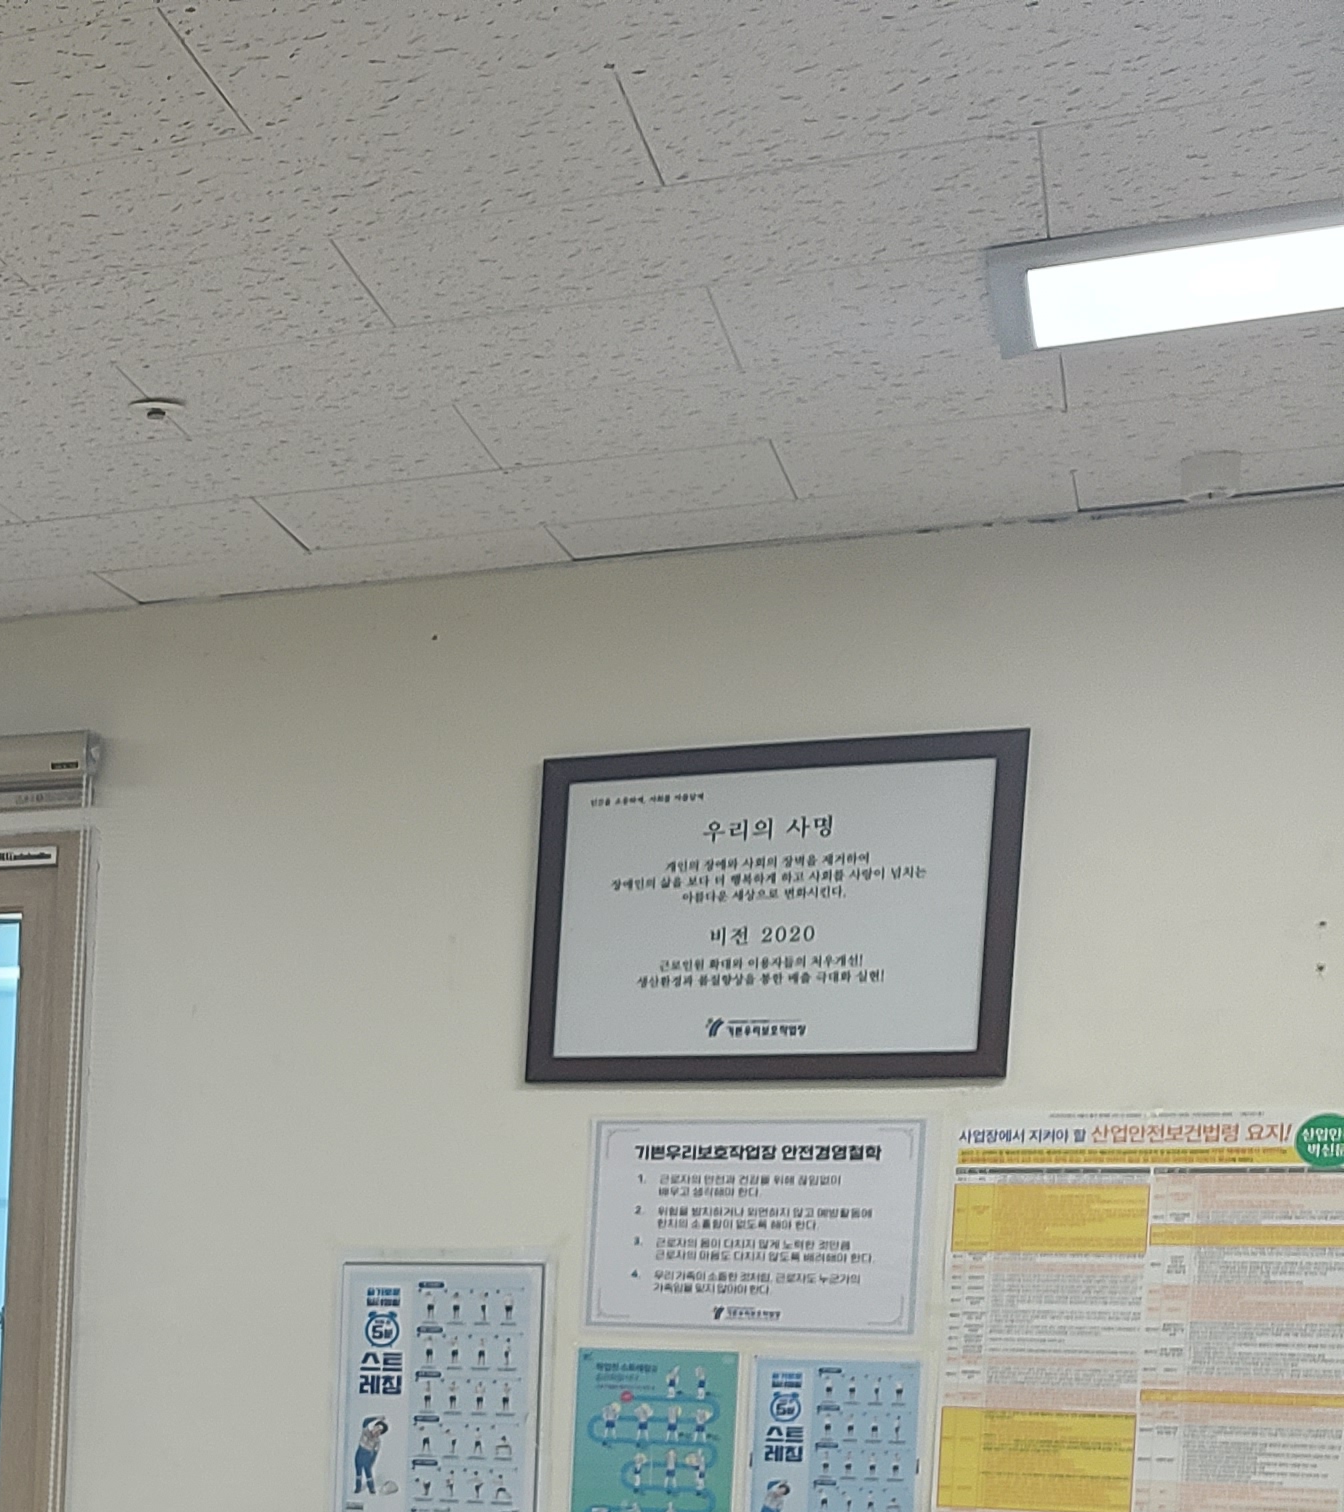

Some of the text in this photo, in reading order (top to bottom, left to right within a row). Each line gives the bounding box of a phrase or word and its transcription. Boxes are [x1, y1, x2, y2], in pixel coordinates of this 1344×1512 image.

[703, 814, 834, 843] 우리의 사명
[710, 925, 815, 946] 비전 2020
[958, 1122, 1293, 1144] 사업장에서 지켜야 할 산업안전보건법령 요지!
[634, 1144, 882, 1161] 기쁜우리보호작업장 안전경영철학
[360, 1352, 403, 1371] 스트
[359, 1375, 402, 1394] 레칭
[766, 1426, 804, 1443] 스트
[764, 1445, 803, 1462] 레칭
